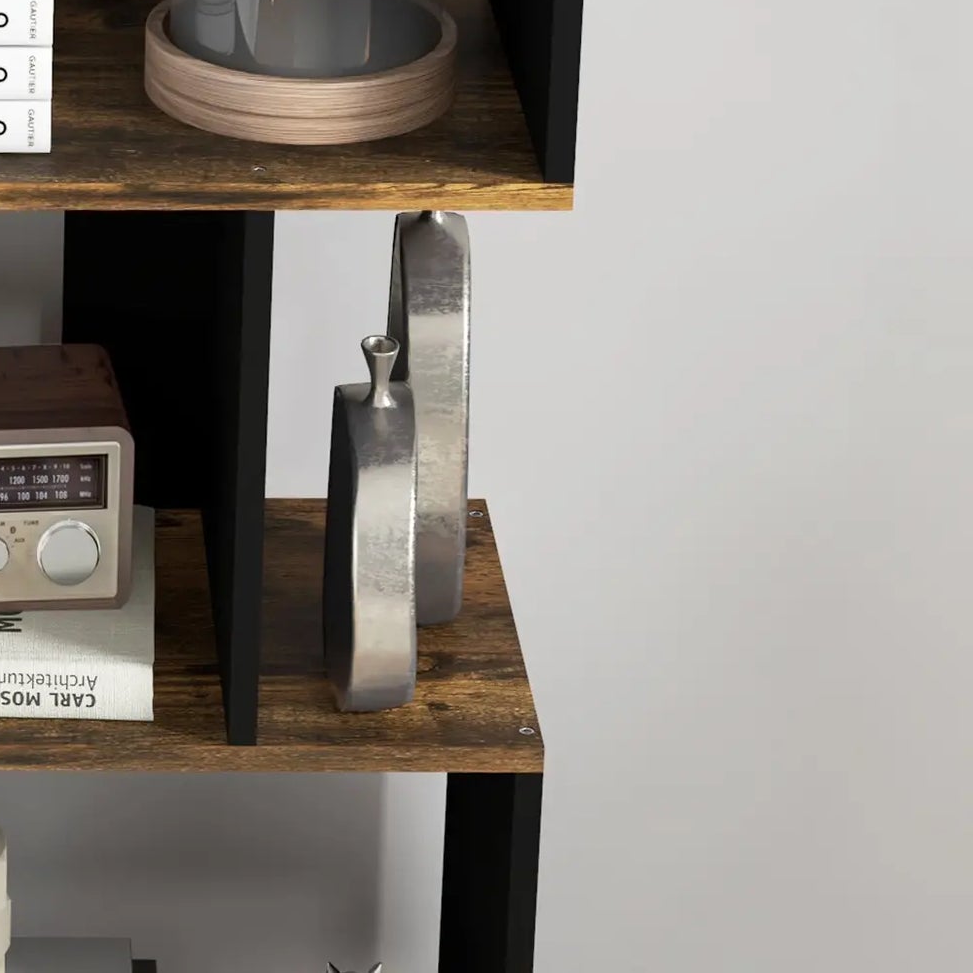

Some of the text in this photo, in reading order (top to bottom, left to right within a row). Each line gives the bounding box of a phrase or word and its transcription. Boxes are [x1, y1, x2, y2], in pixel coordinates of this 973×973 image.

[29, 0, 38, 40] GAUTIER
[28, 55, 36, 94] GAUTIER
[9, 475, 25, 485] 1200
[32, 474, 48, 484] 1500
[52, 474, 69, 483] 1700
[0, 492, 8, 501] 96
[17, 492, 30, 501] 100
[35, 491, 47, 500] 104
[55, 490, 68, 499] 108
[0, 673, 98, 691] Architektur
[52, 692, 96, 707] CARL
